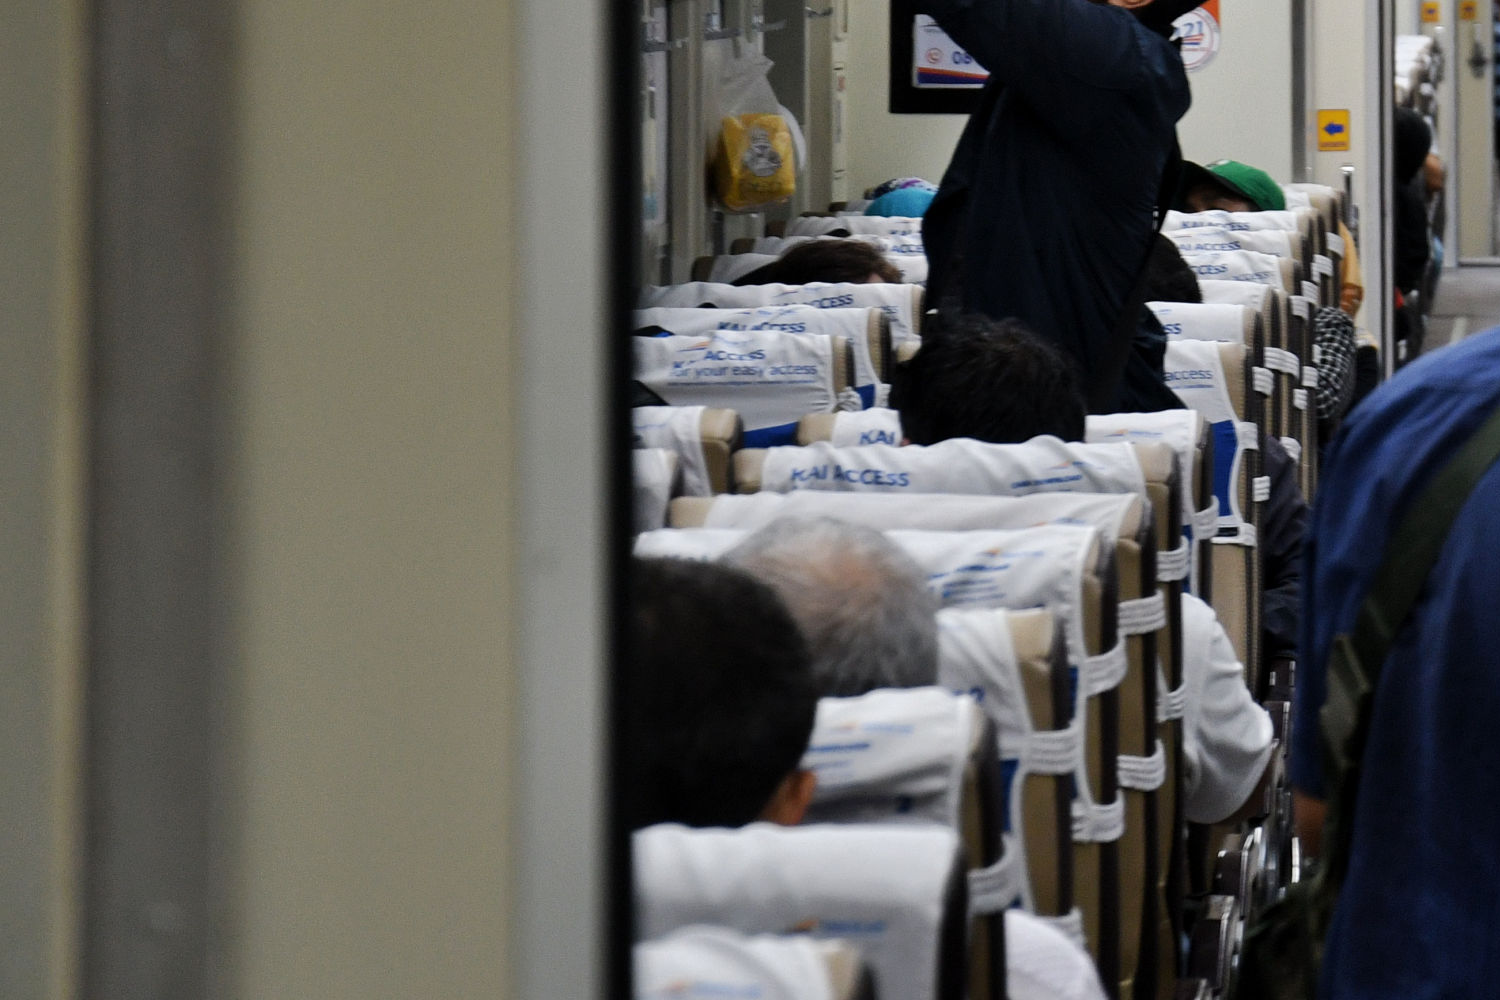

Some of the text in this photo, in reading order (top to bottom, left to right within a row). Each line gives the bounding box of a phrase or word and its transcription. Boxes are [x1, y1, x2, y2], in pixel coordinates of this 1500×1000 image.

[770, 365, 818, 376] access
[790, 464, 910, 487] KAI ACCESS
